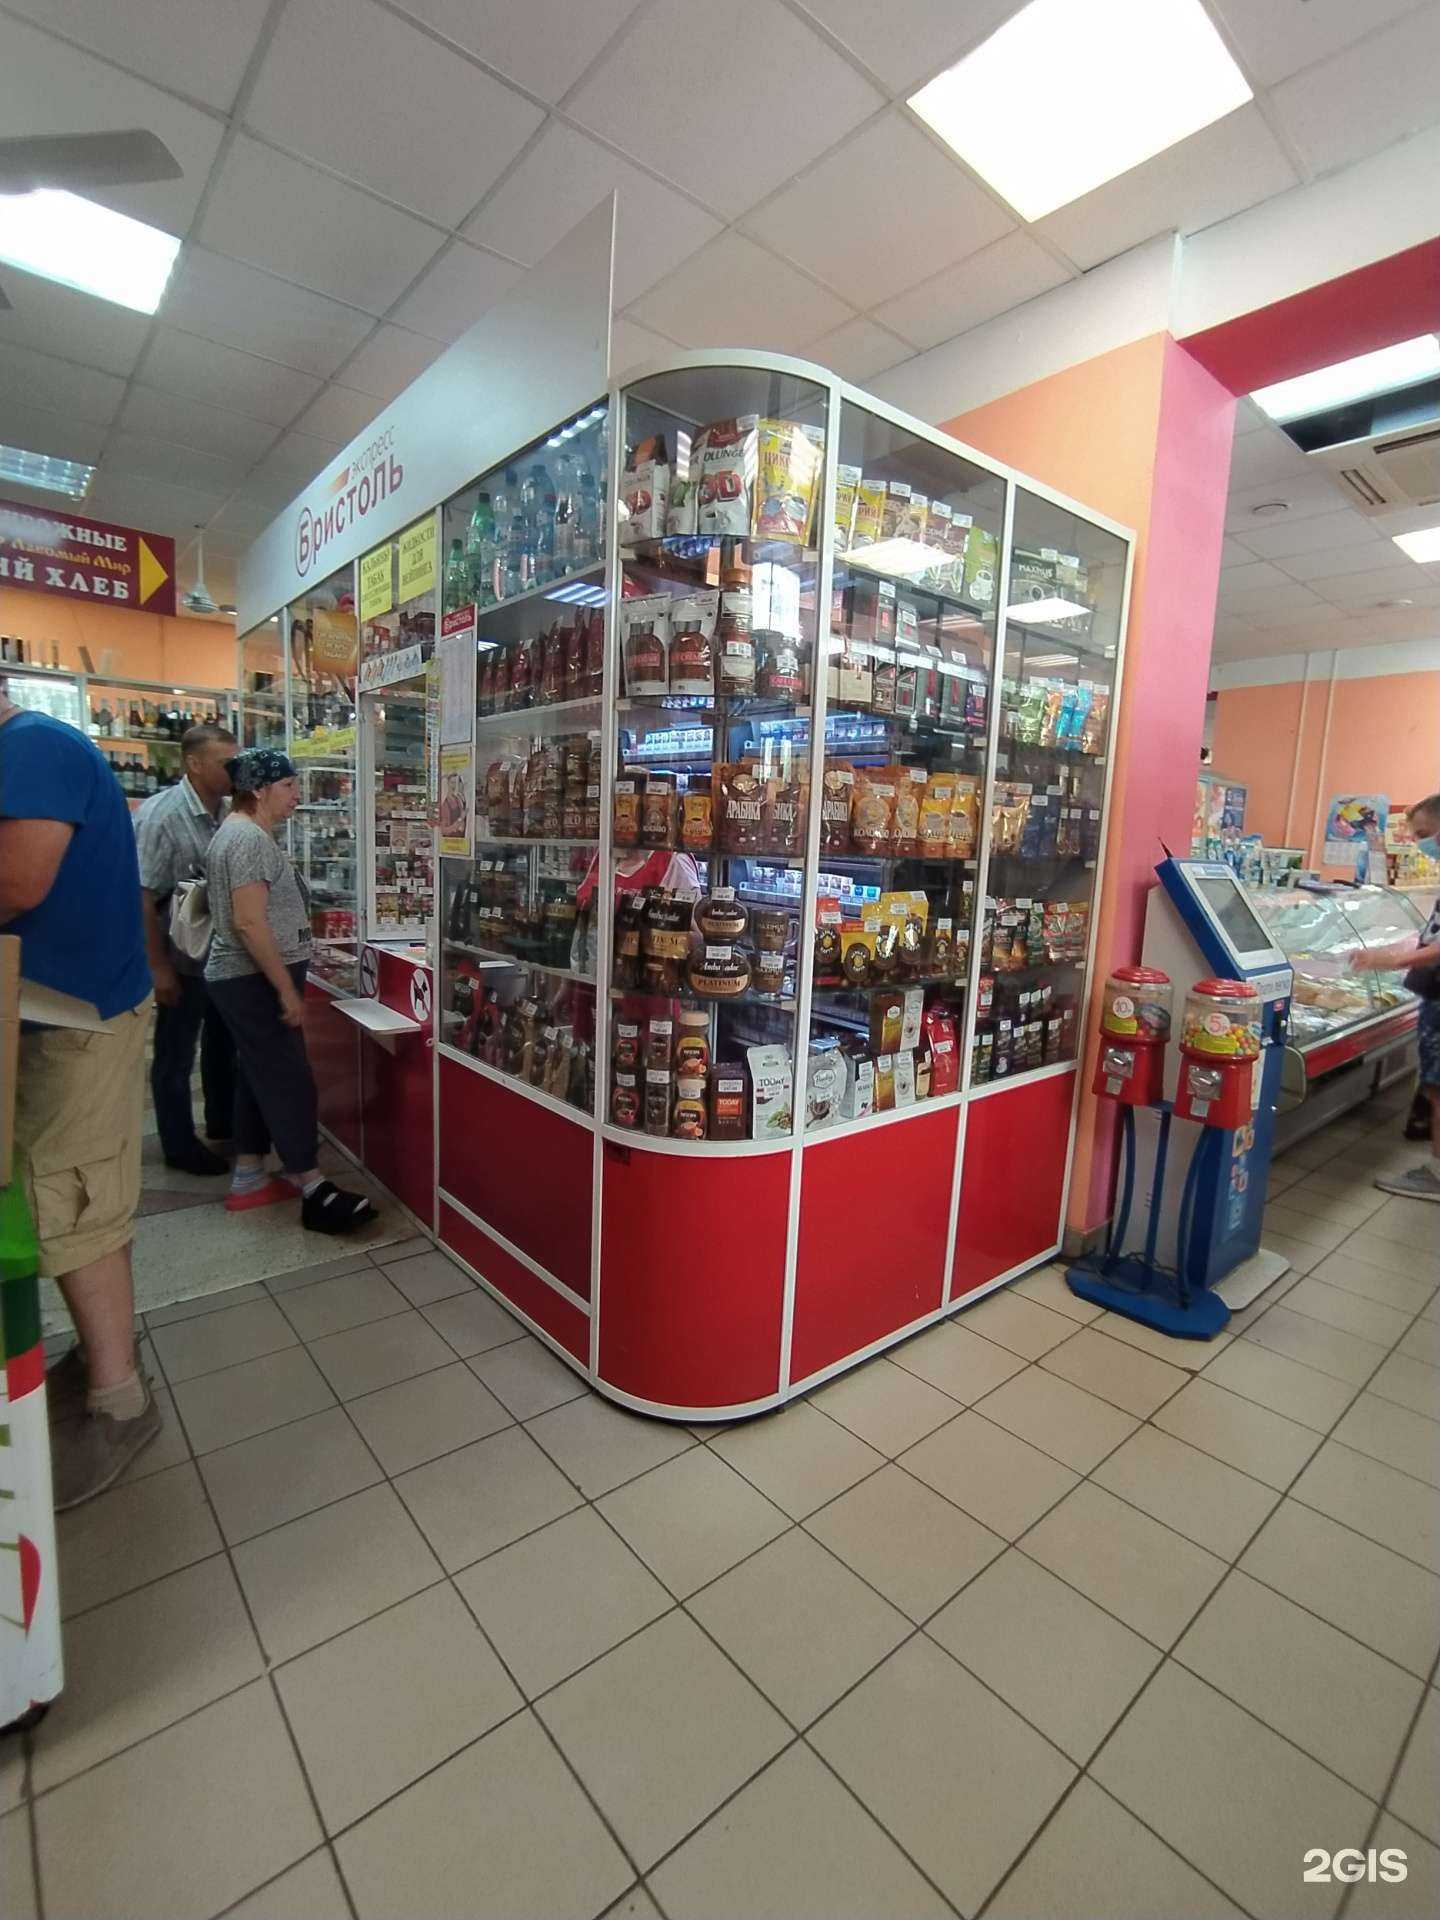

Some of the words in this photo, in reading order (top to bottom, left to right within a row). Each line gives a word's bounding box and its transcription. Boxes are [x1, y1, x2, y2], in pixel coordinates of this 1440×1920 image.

[11, 538, 91, 565] Лакомый
[93, 555, 132, 576] Мир
[45, 566, 130, 600] ХЛЕБ
[726, 800, 761, 820] АРАБИКА
[1210, 1015, 1221, 1032] 5
